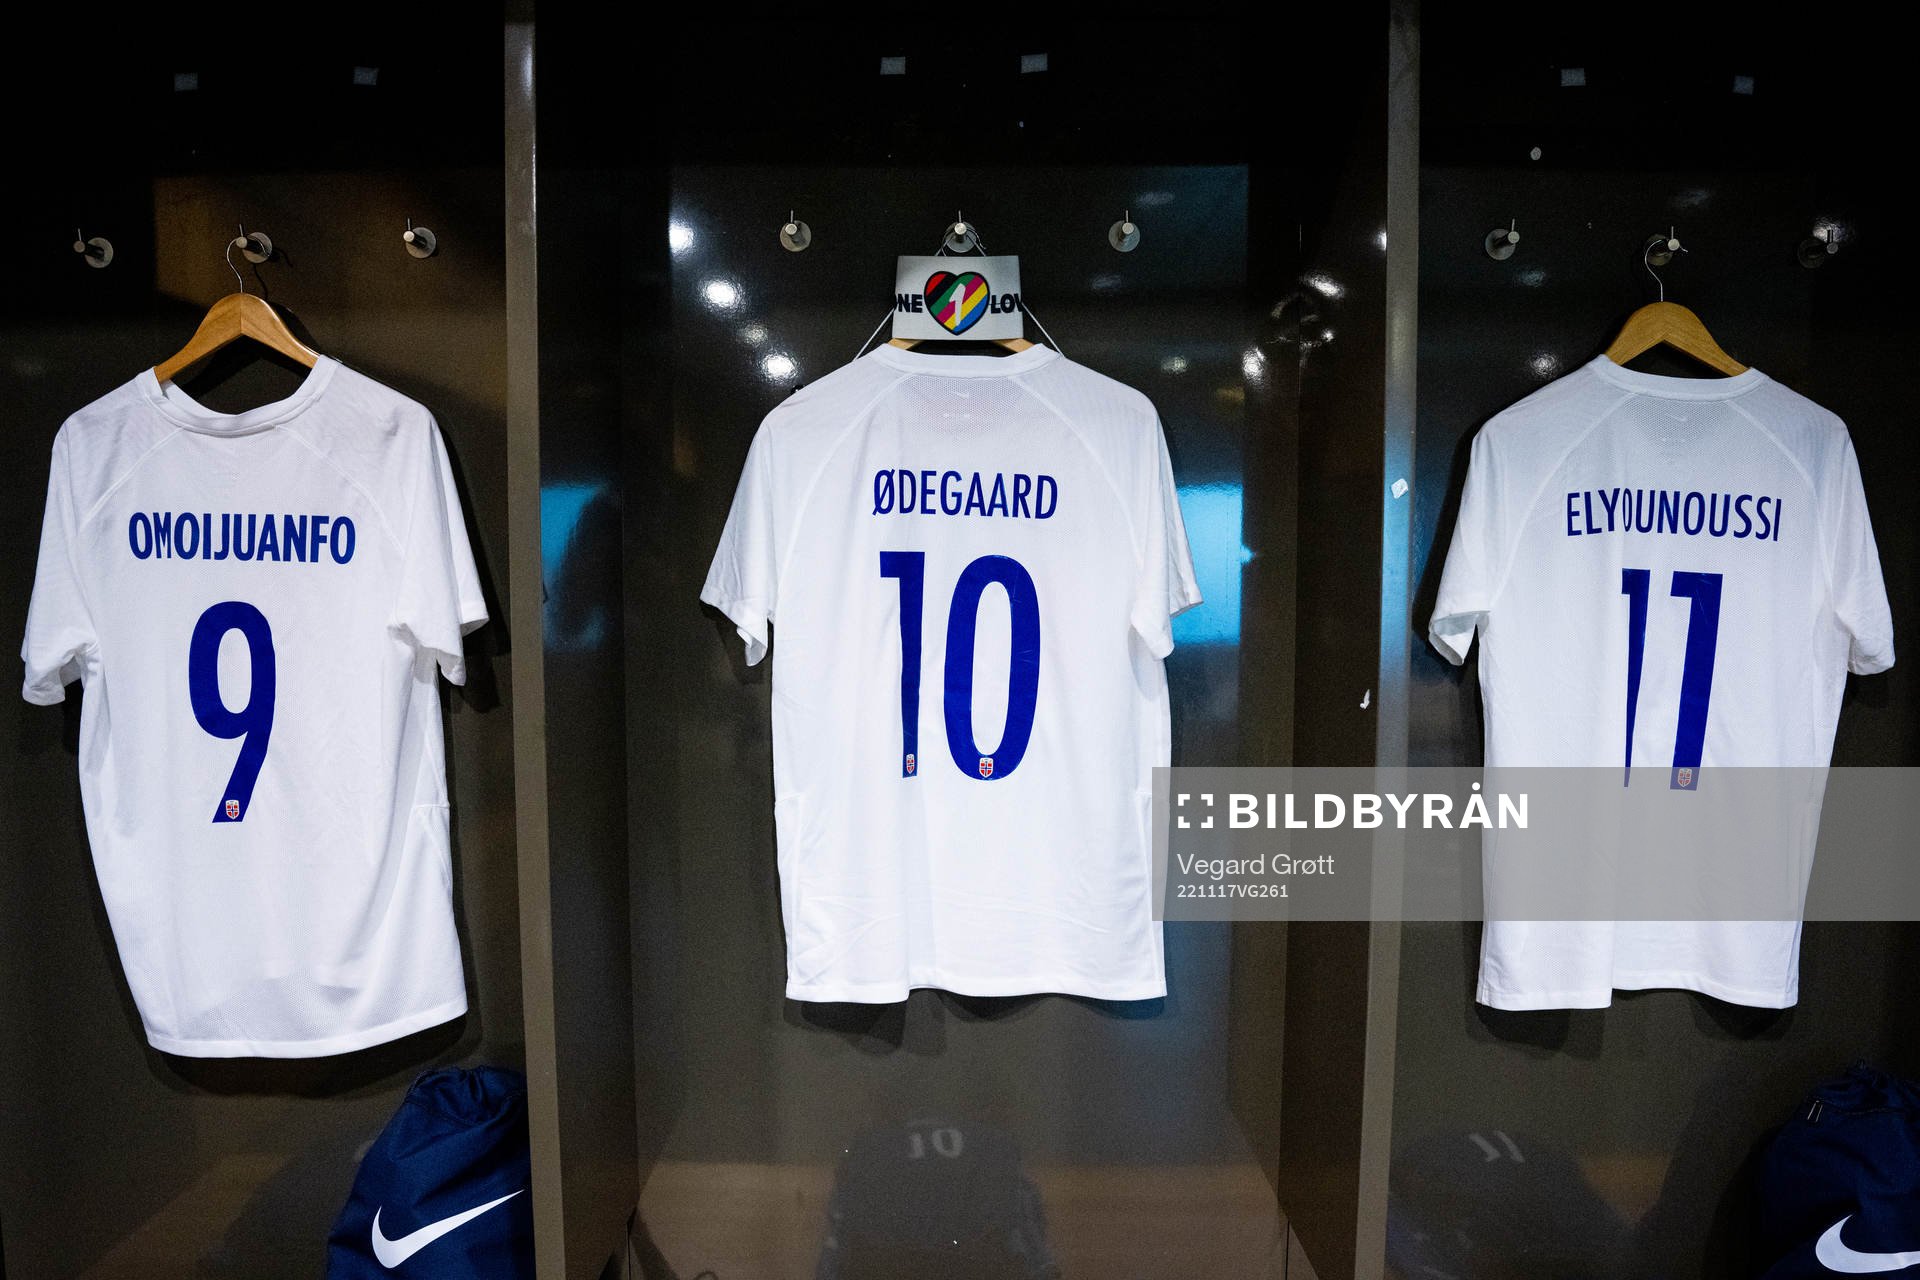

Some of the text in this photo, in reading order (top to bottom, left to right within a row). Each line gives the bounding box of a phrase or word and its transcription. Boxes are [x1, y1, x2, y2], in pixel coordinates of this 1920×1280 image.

[894, 293, 923, 314] NE
[873, 470, 1058, 520] ØDEGAARD
[1567, 488, 1782, 541] ELYOUNOUSSI
[129, 511, 355, 565] OMOIJUANFO
[880, 551, 1040, 781] 10
[1622, 568, 1723, 791] 11
[189, 601, 276, 823] 9
